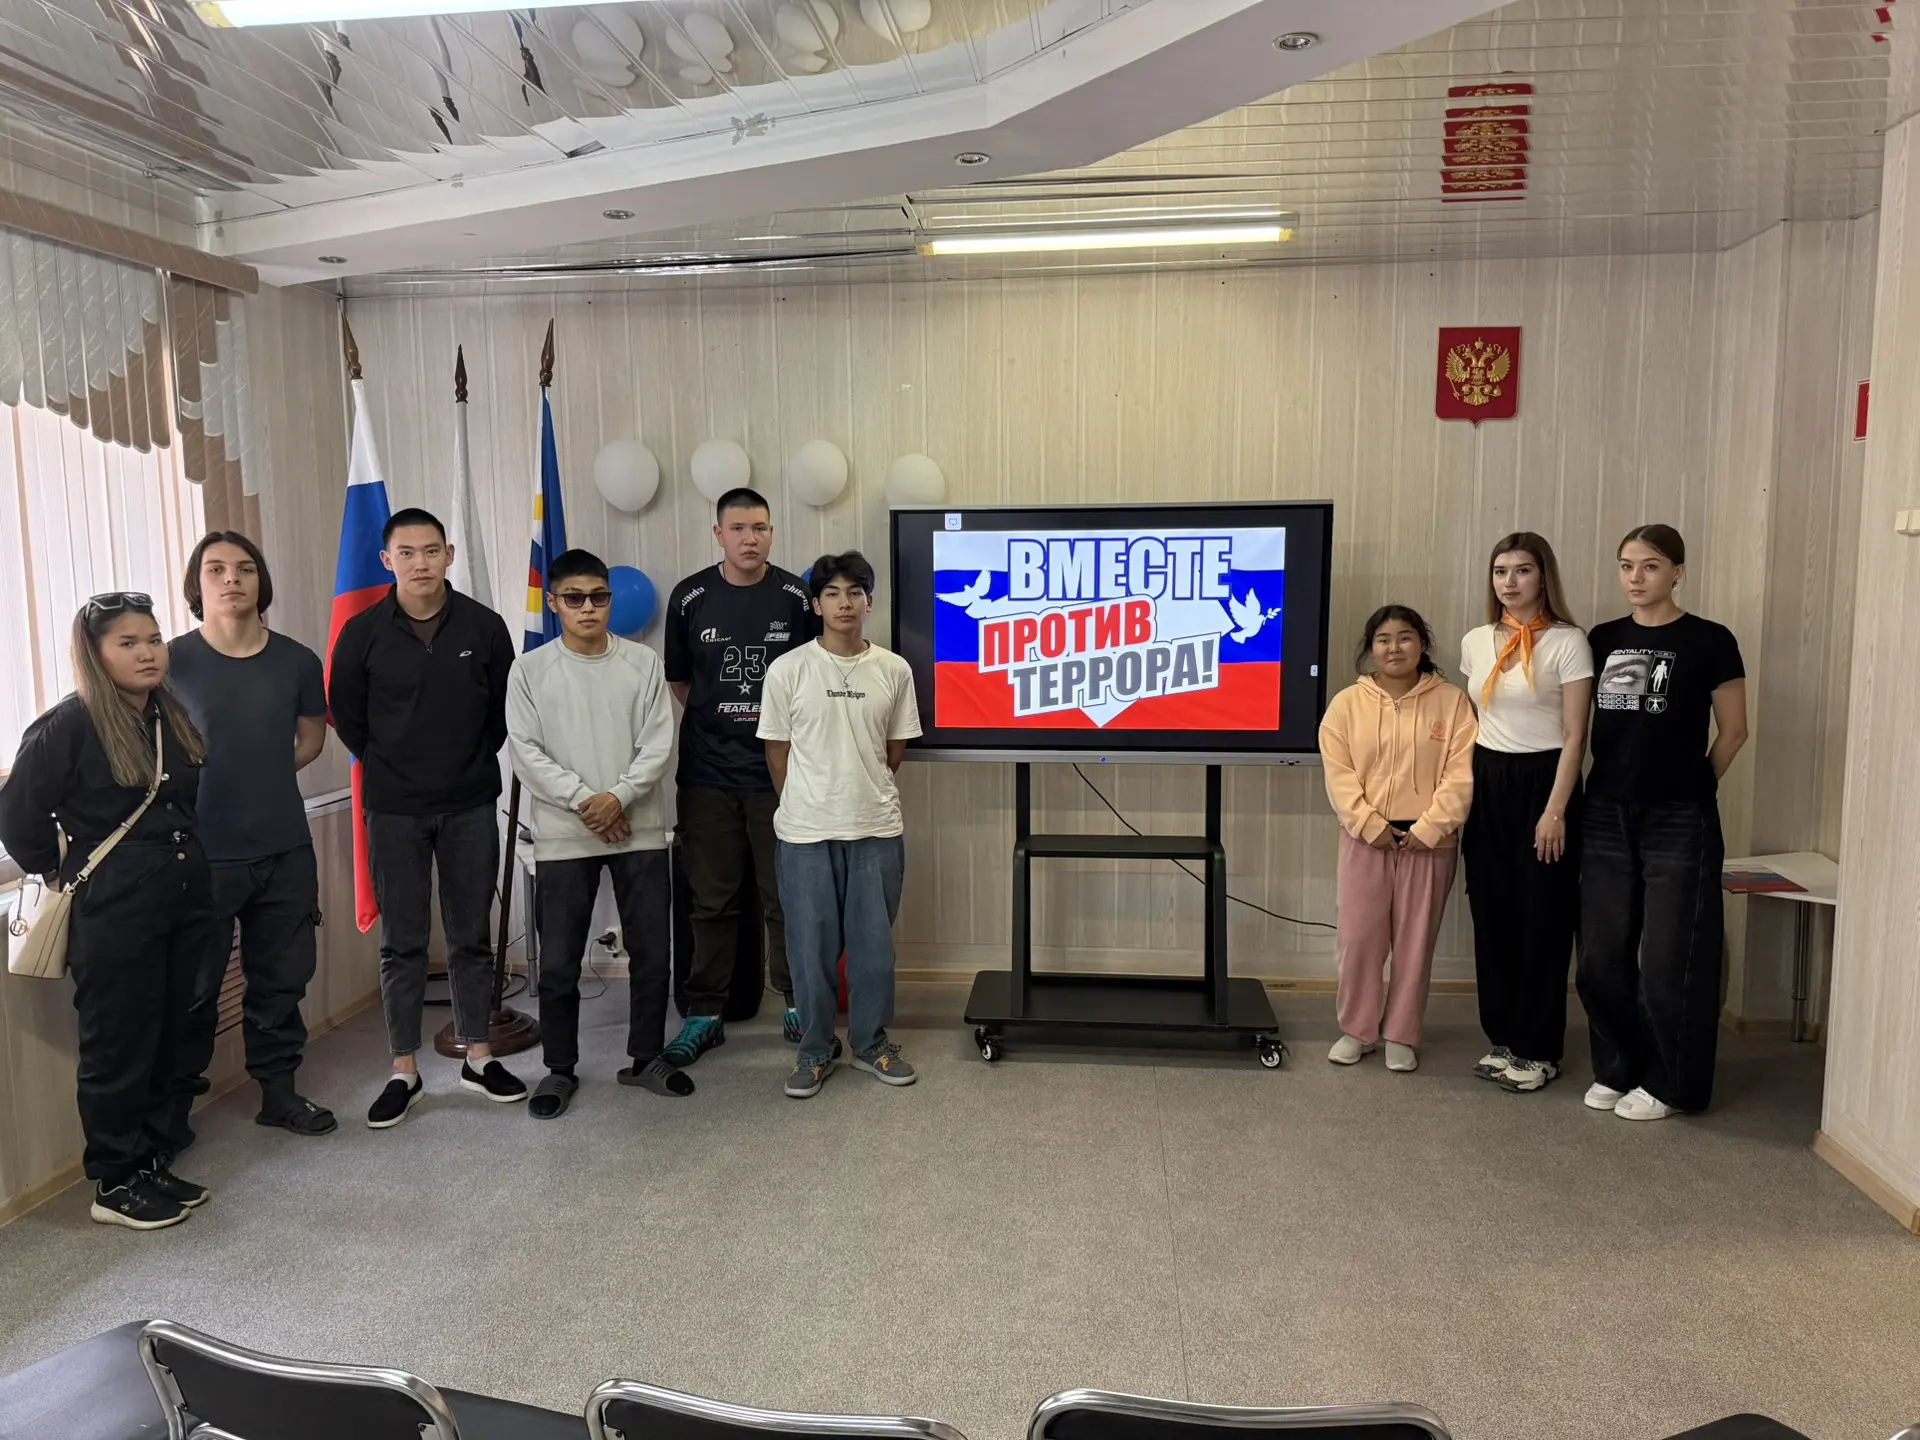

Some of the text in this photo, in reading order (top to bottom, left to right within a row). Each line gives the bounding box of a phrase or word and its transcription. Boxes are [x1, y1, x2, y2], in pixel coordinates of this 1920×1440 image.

[1009, 536, 1232, 600] ВМЕСТЕ
[720, 646, 767, 681] 23
[983, 600, 1152, 667] ПРОТИВ
[1013, 639, 1214, 711] ТЕРРОРА!
